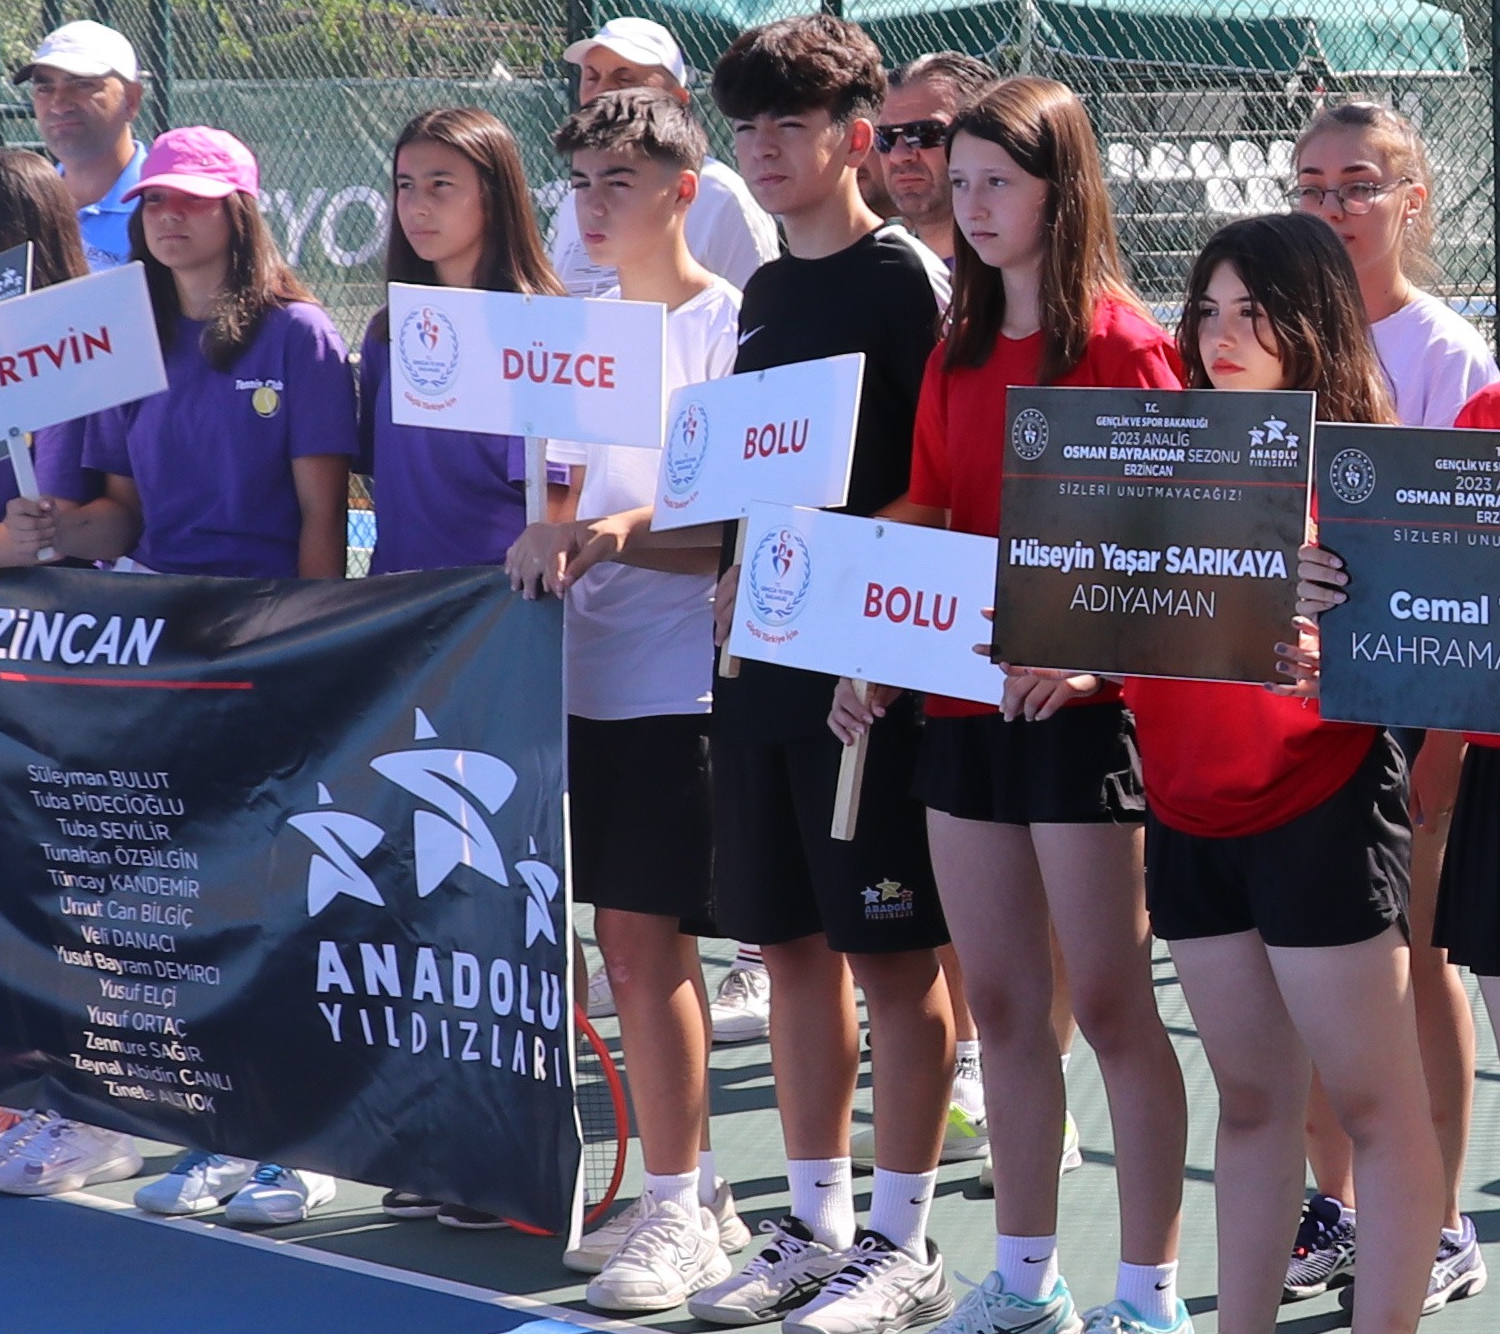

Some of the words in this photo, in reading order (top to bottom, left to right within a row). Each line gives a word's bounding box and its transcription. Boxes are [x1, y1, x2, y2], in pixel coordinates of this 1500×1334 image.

[502, 341, 615, 388] DÜZCE
[235, 379, 263, 390] Tennis
[743, 419, 809, 460] BOLU
[1111, 431, 1140, 444] 2023
[1144, 431, 1190, 447] ANALİG
[1250, 449, 1298, 459] ANADOLU
[1063, 447, 1107, 459] OSMAN
[1110, 447, 1184, 463] BAYRAKDAR
[1188, 451, 1240, 464] SEZONU
[1124, 462, 1173, 477] ERZİNCAN
[1059, 482, 1110, 496] SİZLERİ
[1117, 483, 1242, 501] UNUTMAYACAĞIZ!
[1396, 490, 1451, 506] OSMAN
[1455, 477, 1492, 490] 2023
[1394, 528, 1459, 544] SİZLERİ
[1010, 538, 1094, 574] Hüseyin
[1100, 543, 1161, 576] Yaşar
[1165, 546, 1287, 578] SARIKAYA
[863, 583, 957, 631] BOLU
[1070, 584, 1215, 618] ADIYAMAN
[1389, 591, 1488, 625] Cemal
[28, 765, 107, 789] Süleyman
[110, 771, 168, 789] BULUT
[30, 790, 70, 810] Tuba
[73, 793, 184, 816] PİDECİOĞLU
[56, 818, 98, 838] Tuba
[101, 820, 171, 841] SEVİLİR
[40, 843, 111, 864] Tunahan
[114, 844, 199, 869] ÖZBİLGİN
[47, 869, 105, 893] Tüncay
[110, 874, 200, 898] KANDEMİR
[60, 896, 104, 917] Umut
[107, 900, 136, 921] Can
[141, 901, 193, 929] BİLGİÇ
[81, 925, 109, 946] Veli
[113, 929, 176, 952] DANACI
[53, 945, 93, 967] Yusuf
[95, 952, 152, 977] Bayram
[100, 978, 141, 1001] Yusuf
[144, 984, 176, 1009] ELÇİ
[317, 941, 560, 1030] ANADOLU
[87, 1005, 129, 1028] Yusuf
[133, 1012, 187, 1039] ORTAÇ
[83, 1031, 147, 1056] Zennure
[150, 1040, 203, 1063] SAĞIR
[318, 1002, 561, 1088] YILDIZLARI
[70, 1053, 123, 1077] Zeynal
[127, 1062, 177, 1084] Abidin
[179, 1068, 233, 1091] CANLI
[103, 1080, 155, 1102] Zinete
[158, 1088, 216, 1114] ALTIOK
